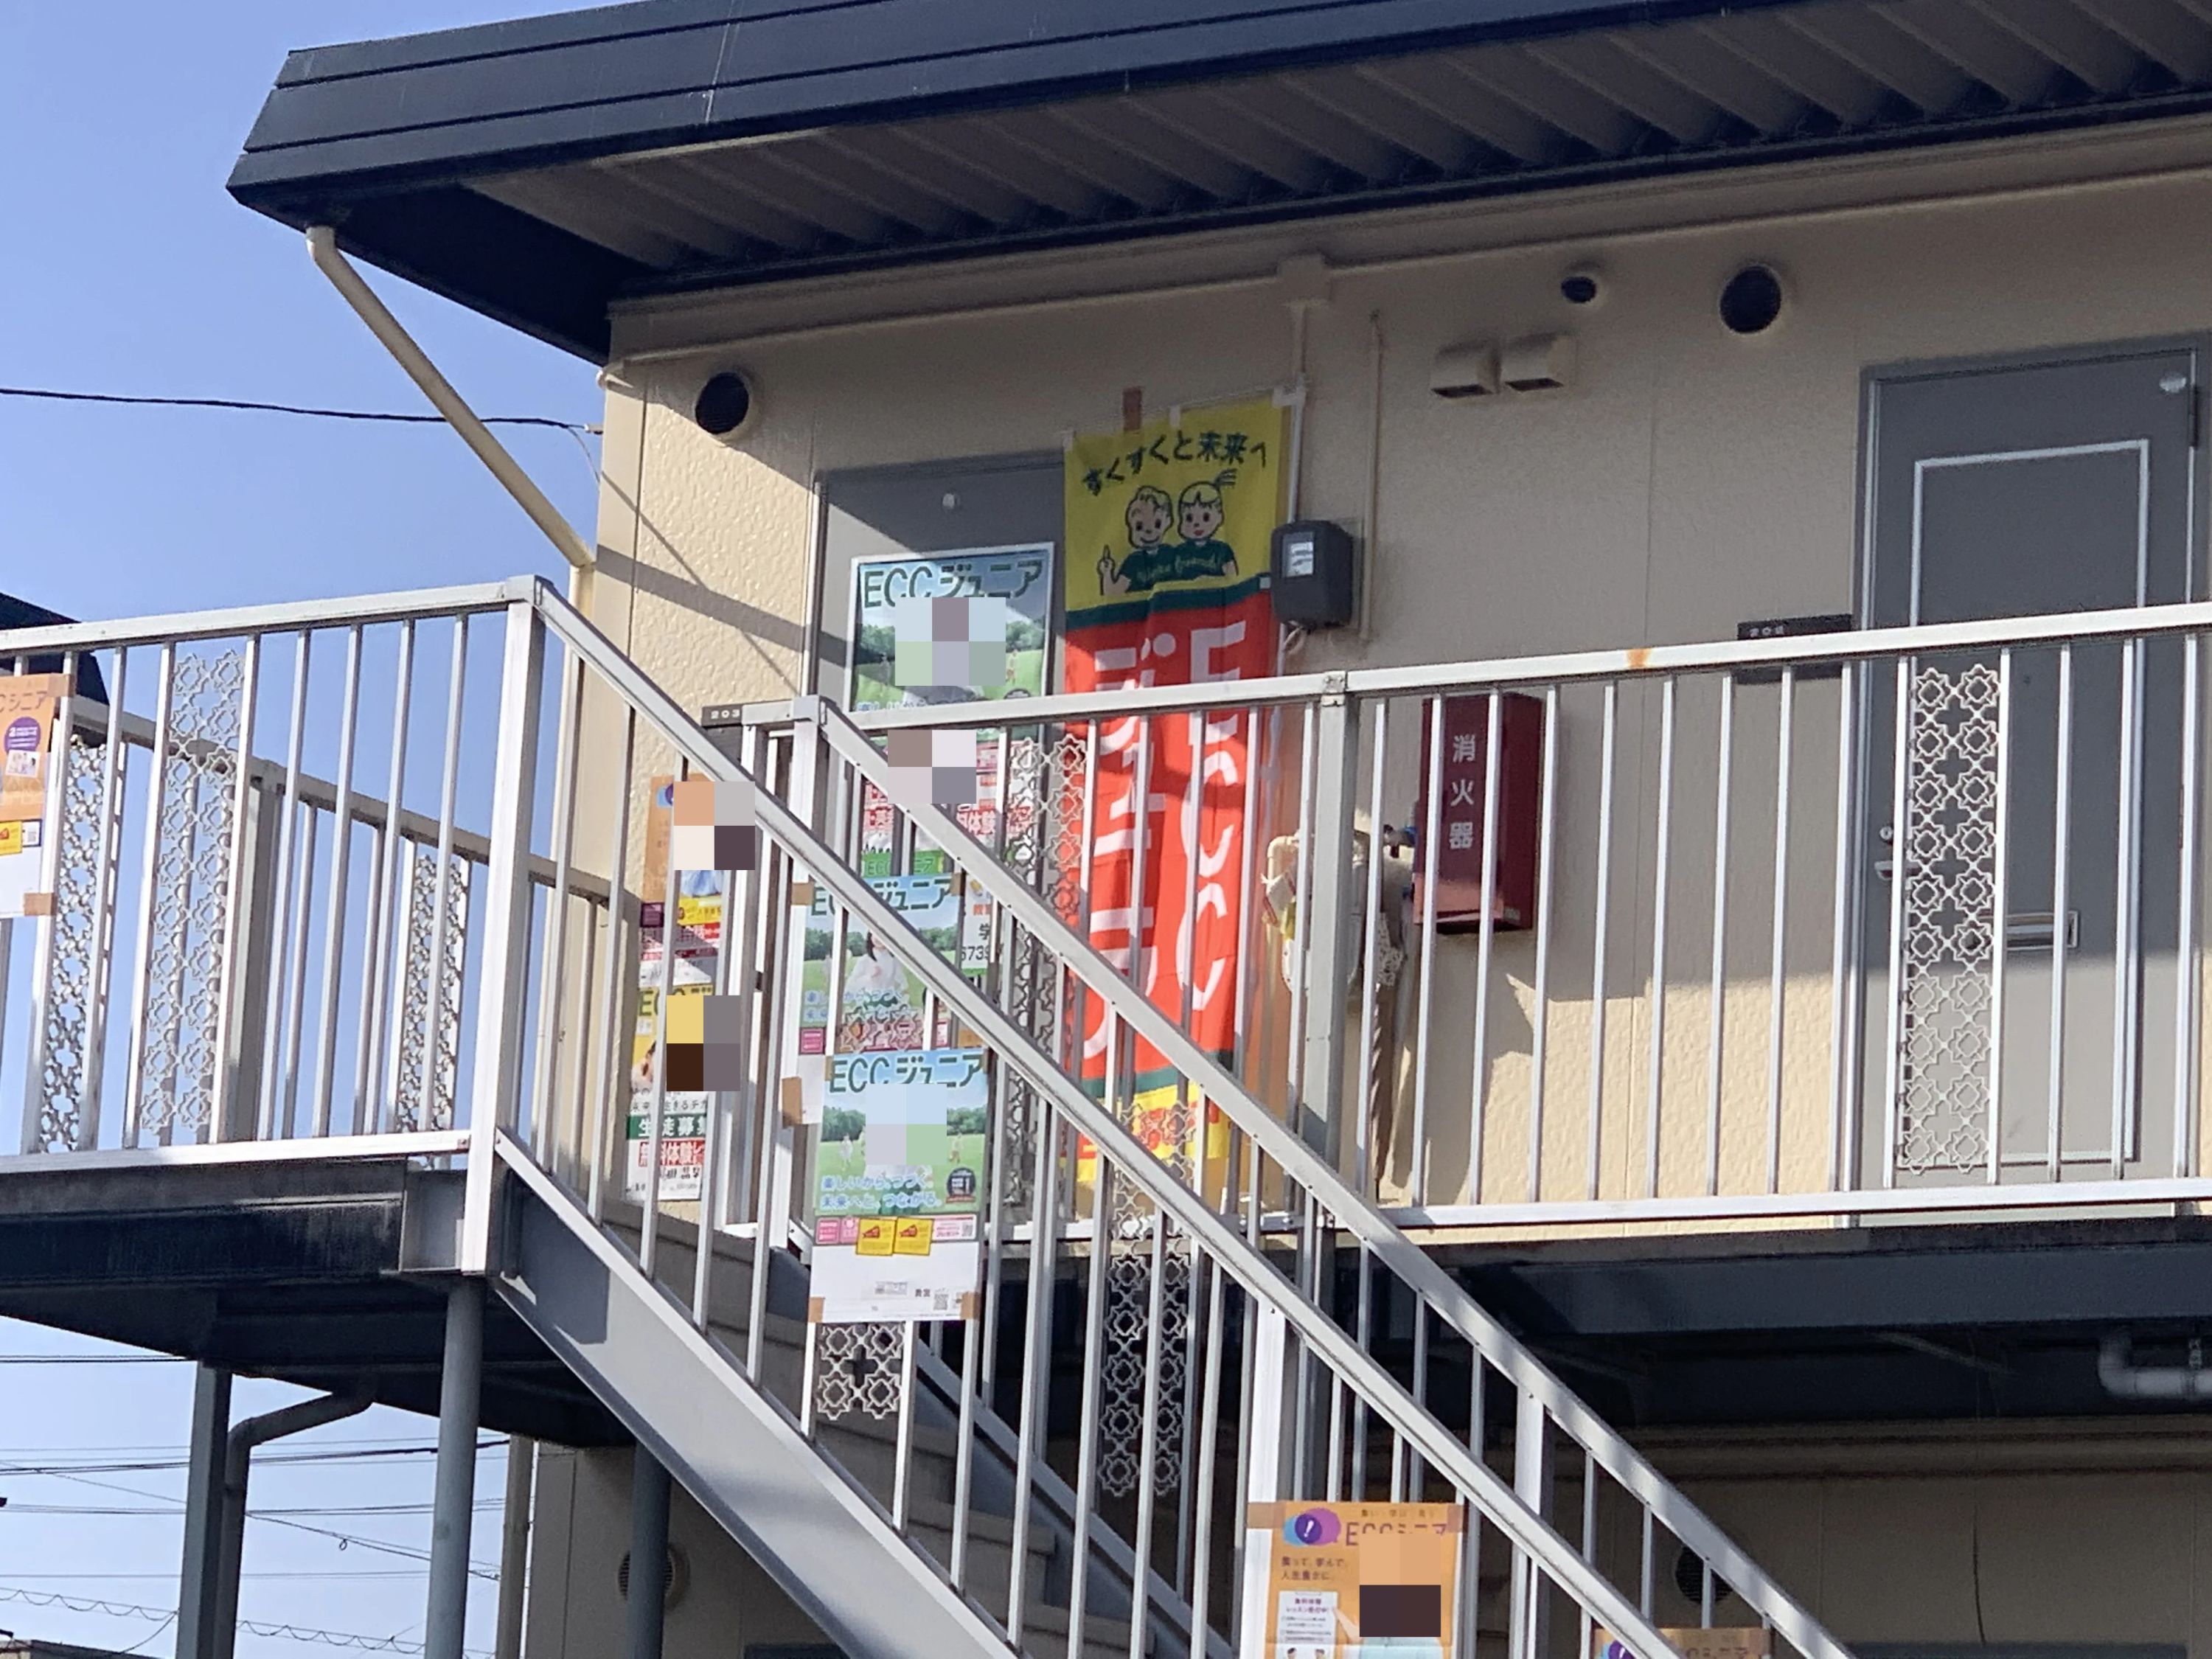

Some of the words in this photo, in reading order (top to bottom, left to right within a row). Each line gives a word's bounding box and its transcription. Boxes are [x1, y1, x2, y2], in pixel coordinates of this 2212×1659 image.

[711, 709, 740, 719] 203
[1448, 733, 1476, 849] 消火器
